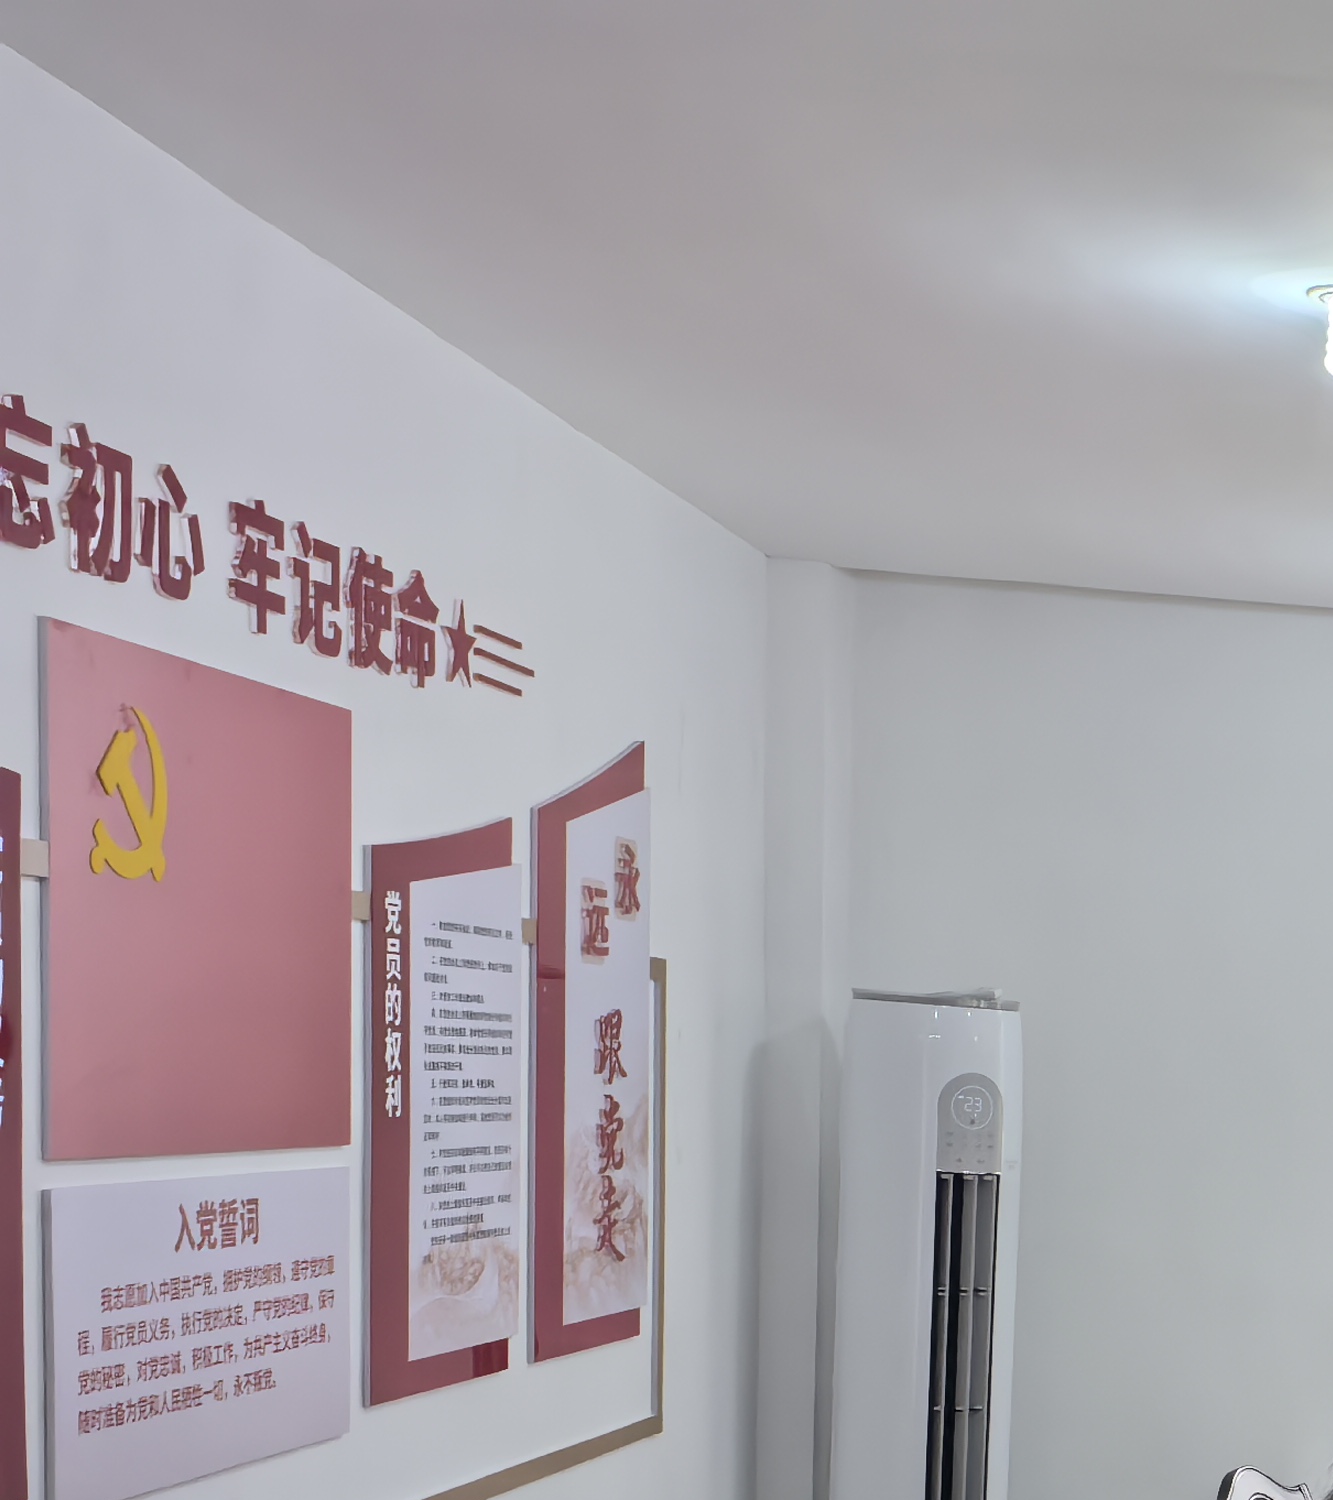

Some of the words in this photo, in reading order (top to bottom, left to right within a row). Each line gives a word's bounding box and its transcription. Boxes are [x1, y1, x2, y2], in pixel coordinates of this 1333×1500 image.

[227, 499, 440, 689] 牢记使命
[384, 890, 403, 1118] 党员的权利
[963, 1097, 982, 1112] 23
[174, 1197, 261, 1253] 入党誓词
